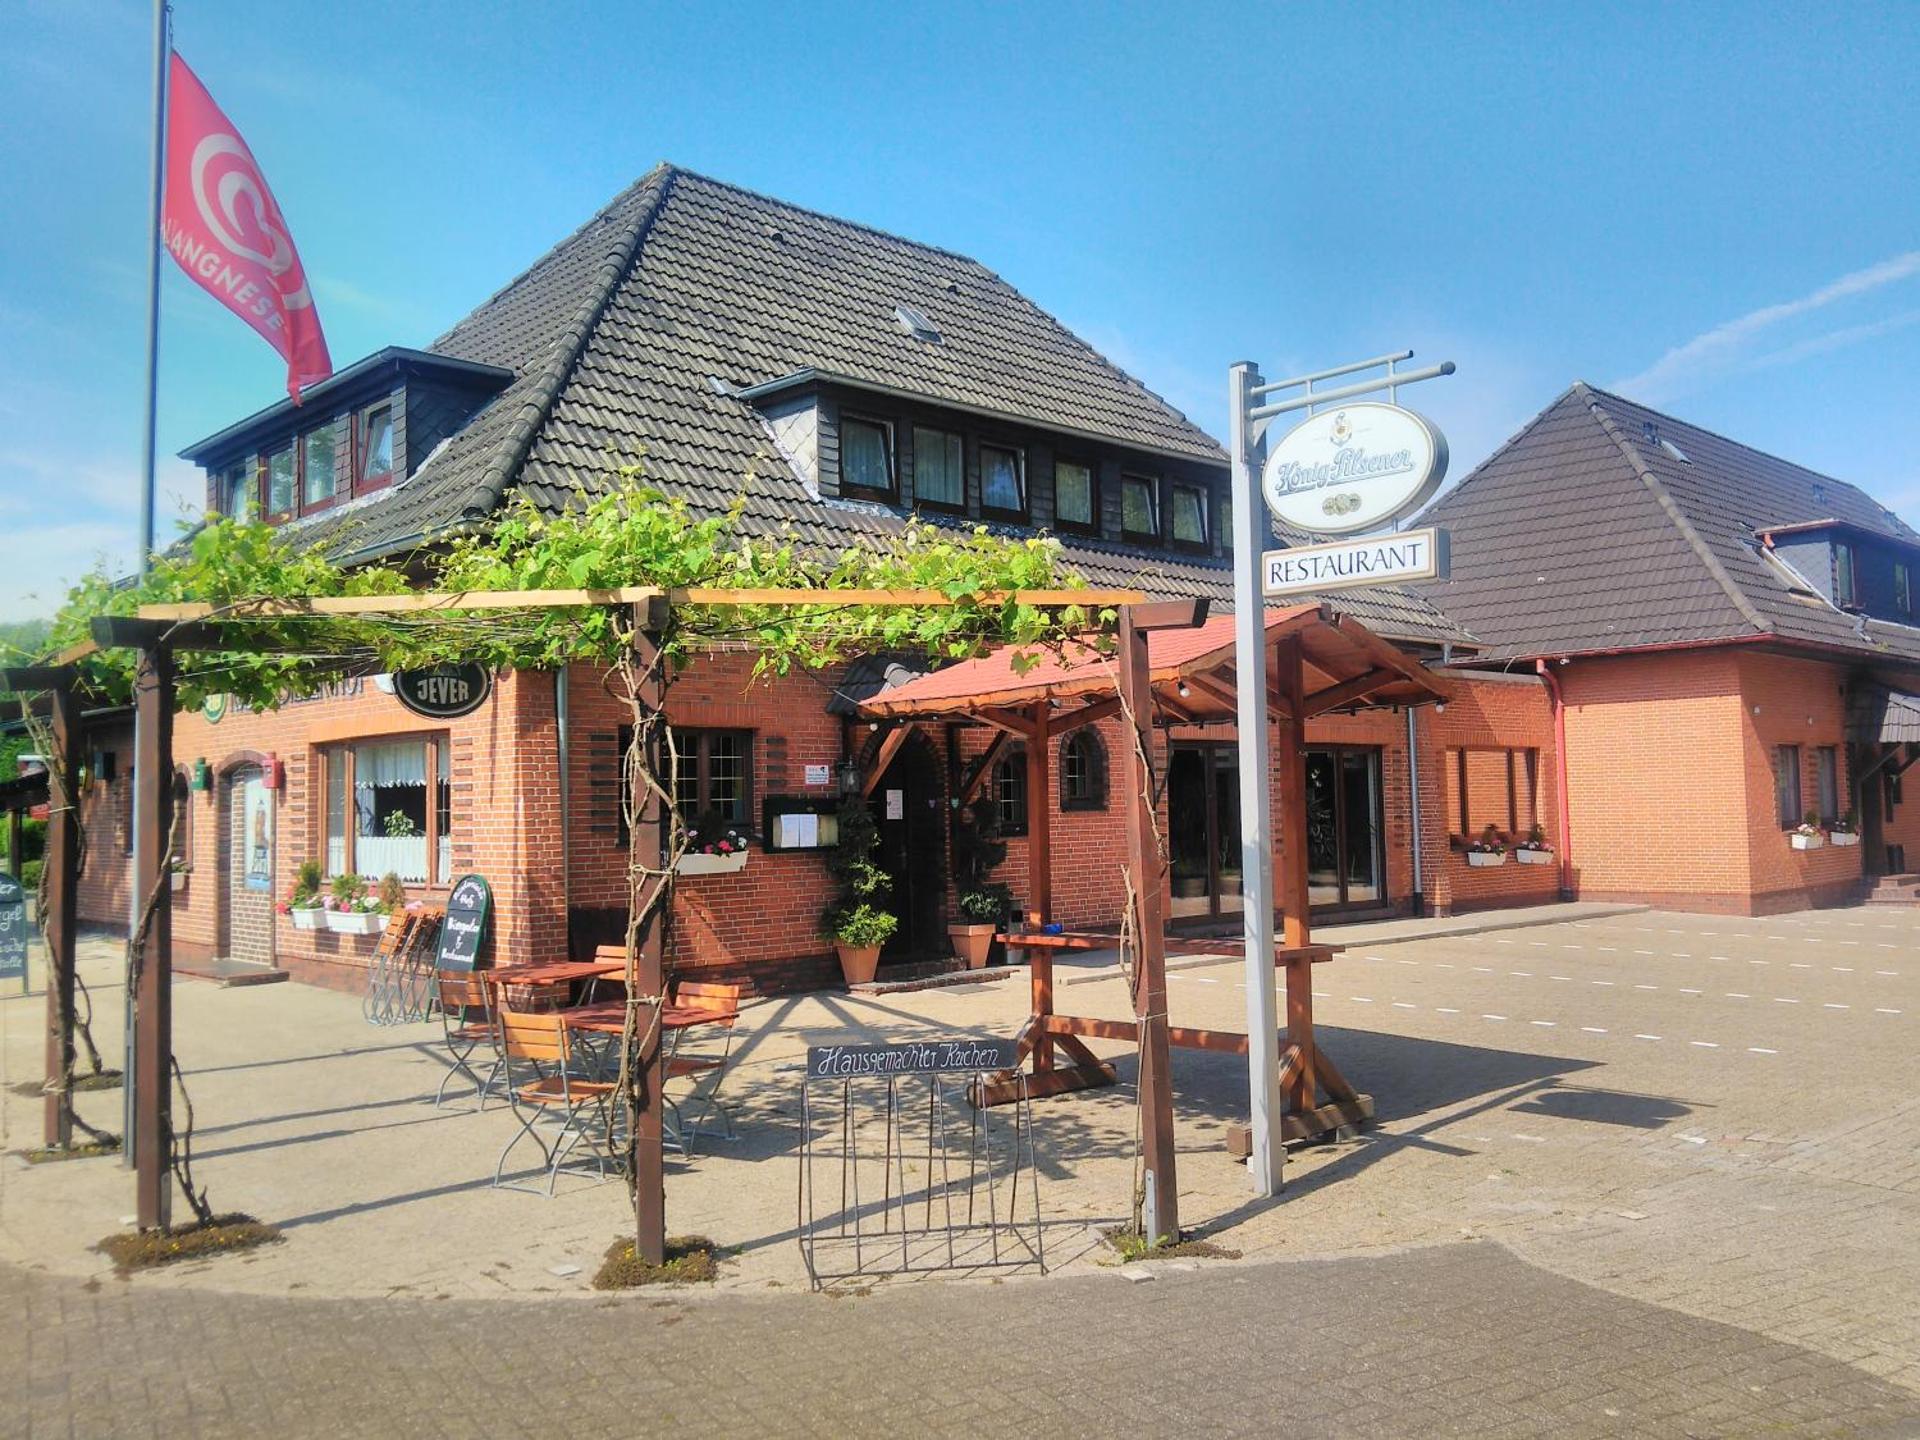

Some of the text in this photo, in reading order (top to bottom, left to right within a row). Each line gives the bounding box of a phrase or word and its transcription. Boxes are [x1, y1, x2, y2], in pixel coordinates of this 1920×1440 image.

[1270, 543, 1424, 584] RESTAURANT
[416, 676, 470, 705] JEVER
[817, 1041, 1000, 1075] Hausgemachter Kuchen
